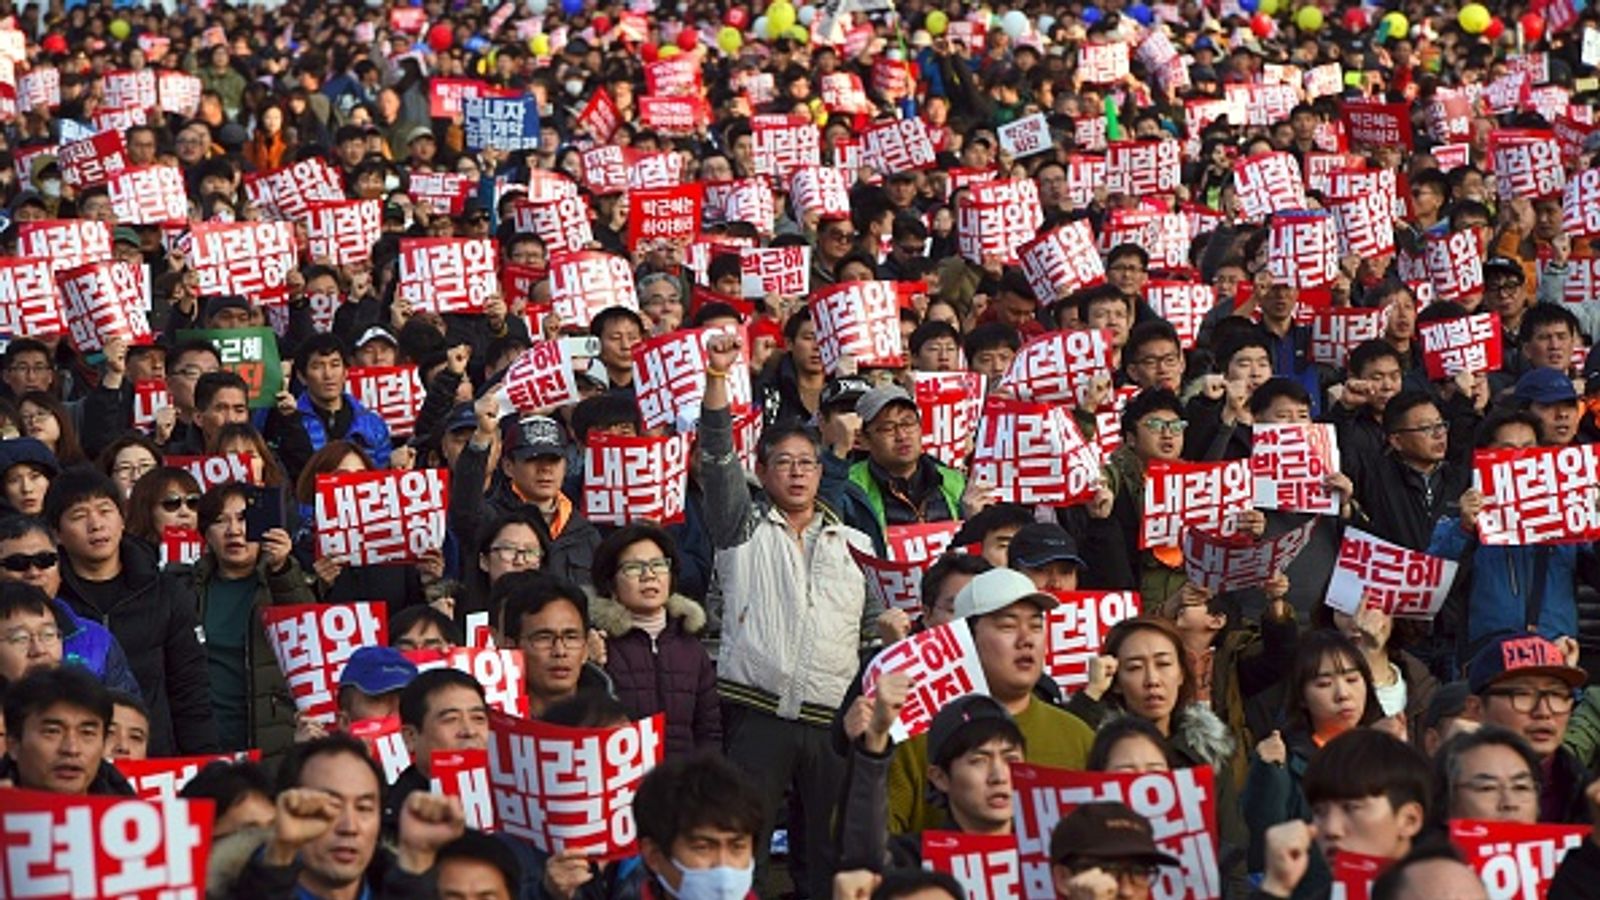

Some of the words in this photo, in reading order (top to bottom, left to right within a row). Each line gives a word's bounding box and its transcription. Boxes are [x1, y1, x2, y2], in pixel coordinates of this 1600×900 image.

[752, 125, 820, 153] 내려와
[861, 117, 927, 162] 내려와
[1107, 140, 1181, 174] 내려와
[1497, 139, 1561, 176] 내려와
[109, 165, 184, 201] 내려와
[246, 157, 325, 208] 내려와
[409, 174, 467, 197] 재벌도
[587, 165, 627, 188] 박근
[1107, 161, 1181, 195] 박근혜
[112, 190, 188, 225] 박근혜
[306, 199, 382, 243] 내려와
[514, 197, 592, 233] 내려와
[641, 197, 695, 217] 박근혜는
[642, 216, 694, 236] 하야하라
[959, 202, 1033, 237] 내려와
[20, 220, 112, 260] 내려와
[193, 221, 291, 271] 내려와
[542, 222, 594, 254] 근혜
[1021, 218, 1094, 284] 내려와
[1270, 218, 1339, 257] 내려와
[197, 253, 292, 297] 박근혜
[399, 239, 498, 286] 내려와
[551, 254, 634, 298] 내려와
[742, 248, 803, 276] 박근혜
[764, 272, 803, 296] 퇴진
[1429, 256, 1485, 301] 근혜
[65, 264, 142, 329] 내려와
[401, 272, 498, 314] 박근혜
[813, 280, 898, 346] 내려와
[213, 336, 262, 363] 근혜
[819, 318, 902, 376] 박근혜
[1311, 312, 1390, 346] 내려
[1420, 312, 1494, 353] 재벌도
[507, 342, 562, 387] 근혜
[634, 325, 740, 391] 내려
[1441, 342, 1489, 376] 공범
[507, 371, 571, 412] 퇴진
[584, 435, 690, 489] 내려와
[976, 443, 1103, 504] 박근혜
[1474, 444, 1600, 509] 내려와
[315, 467, 443, 531] 내려와
[586, 474, 689, 526] 박근혜
[1144, 460, 1255, 517] 내려와
[1276, 482, 1331, 511] 퇴진
[317, 510, 446, 567] 박근혜
[1477, 490, 1600, 546] 박근혜
[1339, 538, 1444, 589] 박근혜
[1361, 585, 1432, 619] 퇴진
[267, 602, 381, 677] 려와
[488, 716, 658, 802] 내려와
[0, 799, 200, 900] 려와
